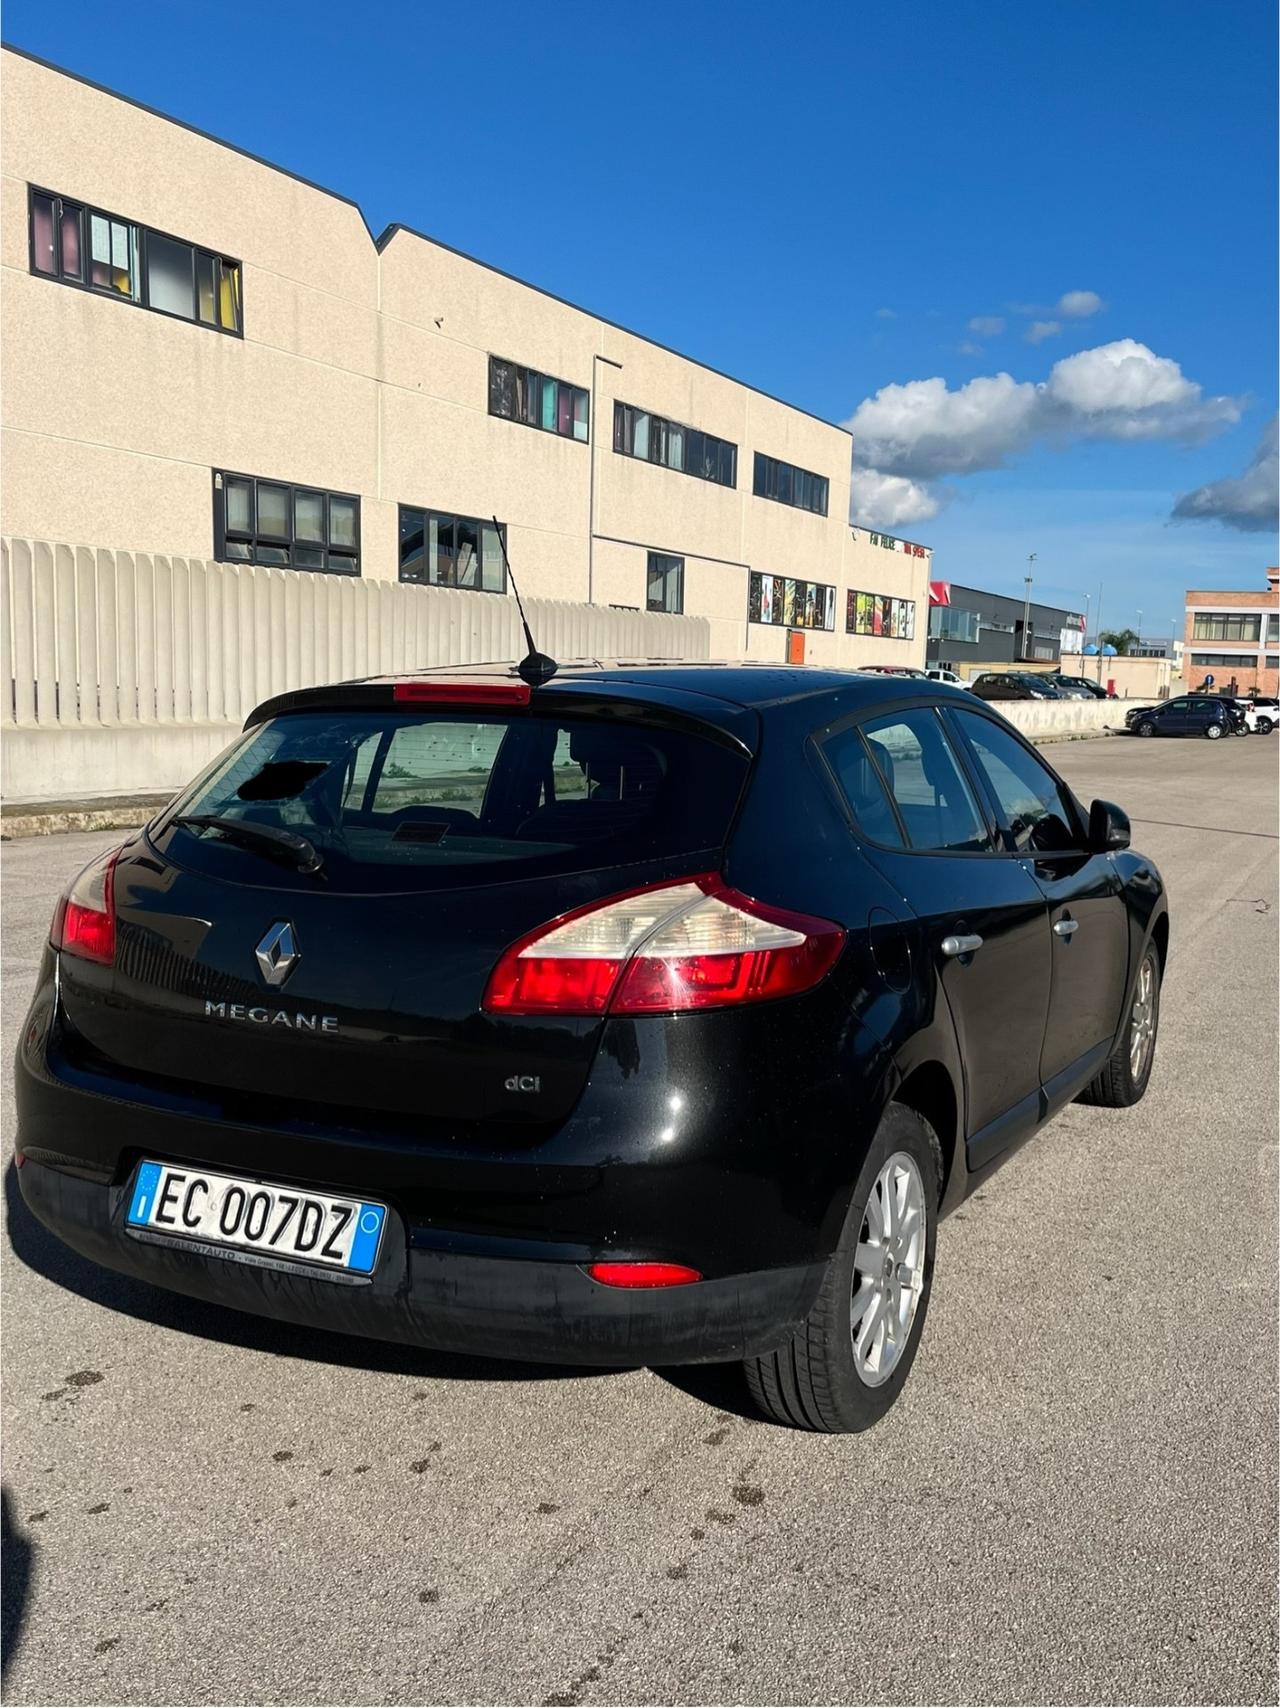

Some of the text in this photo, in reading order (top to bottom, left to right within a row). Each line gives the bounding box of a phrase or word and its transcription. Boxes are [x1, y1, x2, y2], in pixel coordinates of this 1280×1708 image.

[204, 1000, 340, 1033] MEGANE
[154, 1172, 354, 1260] EC 007DZ
